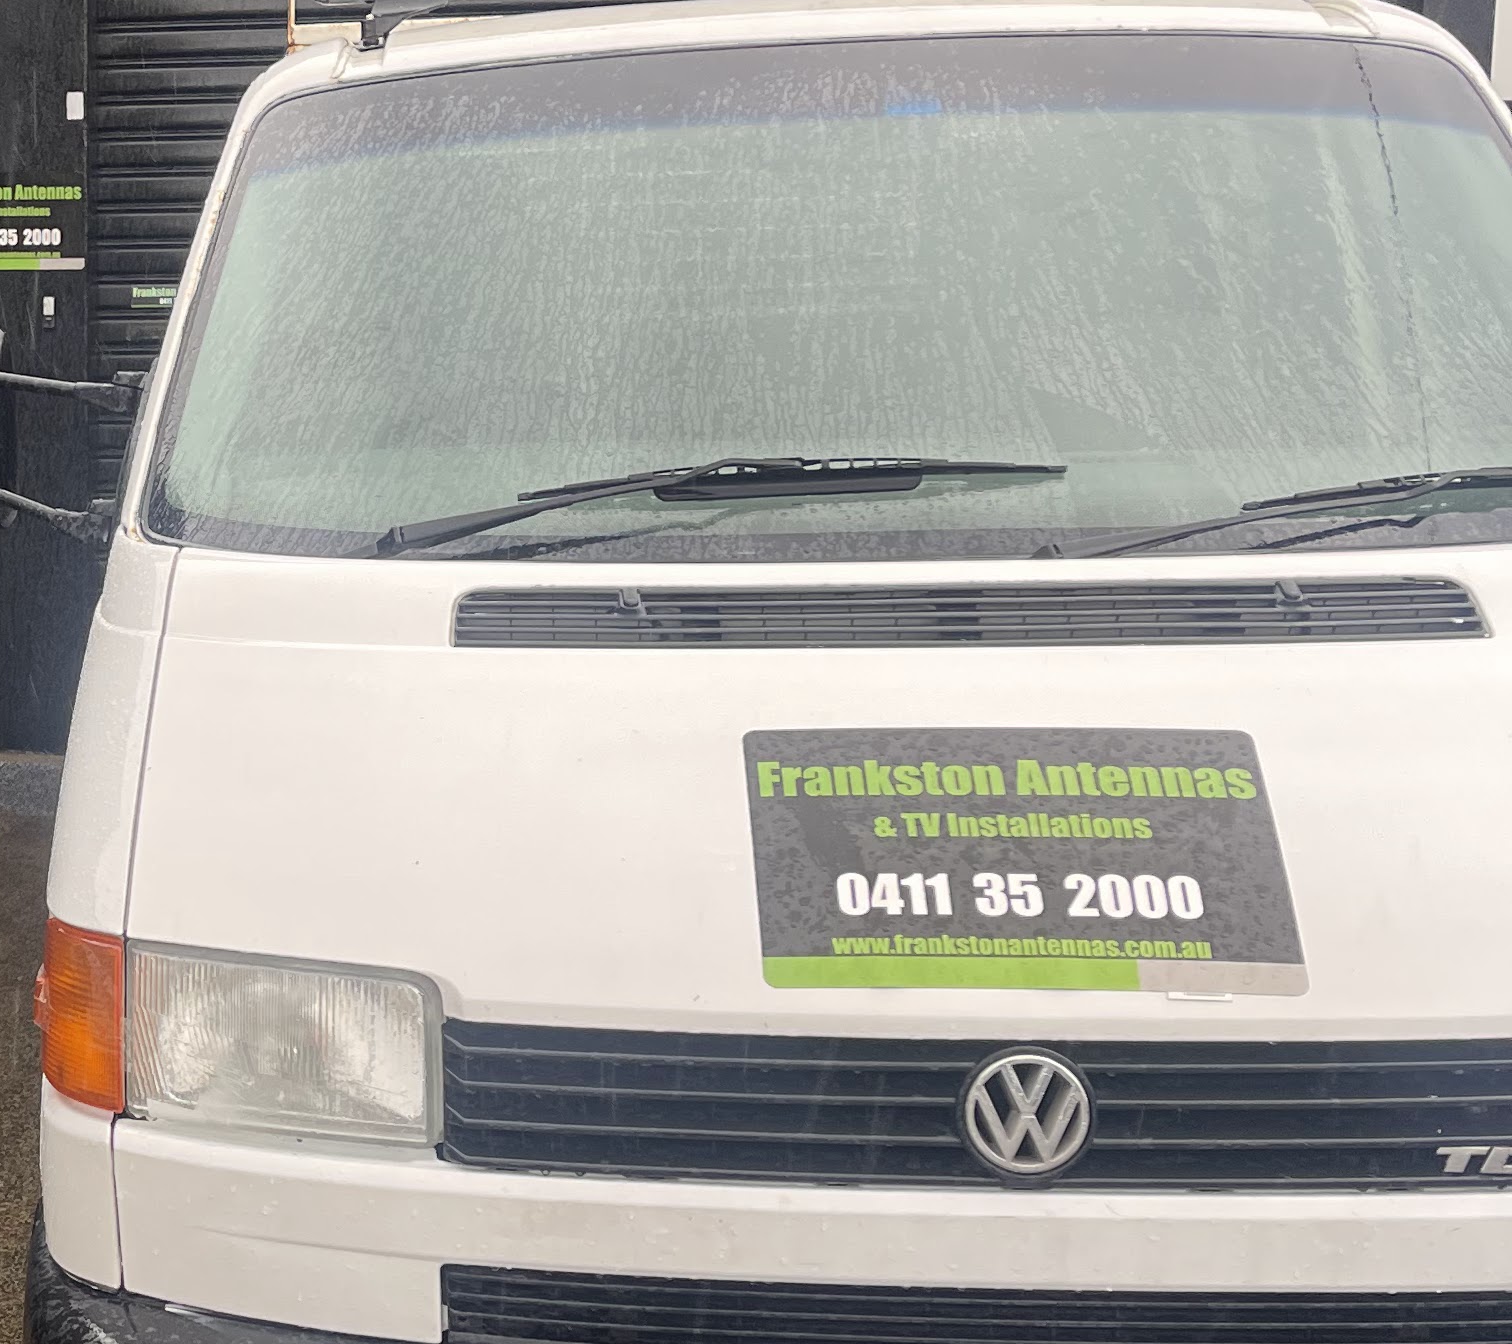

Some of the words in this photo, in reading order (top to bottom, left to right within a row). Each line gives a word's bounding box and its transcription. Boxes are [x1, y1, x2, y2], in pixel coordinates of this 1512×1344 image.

[14, 184, 82, 201] Antennas
[22, 228, 62, 246] 2000
[132, 286, 177, 298] Frankston
[756, 759, 1005, 798] Frankston
[1015, 759, 1257, 800] Antennas
[874, 816, 897, 838] &
[900, 812, 941, 838] TV
[947, 813, 1153, 840] Installations
[836, 872, 953, 916] 0411
[972, 872, 1044, 917] 35
[1063, 874, 1205, 920] 2000
[831, 934, 1213, 959] www.frankstonantennas.com.au
